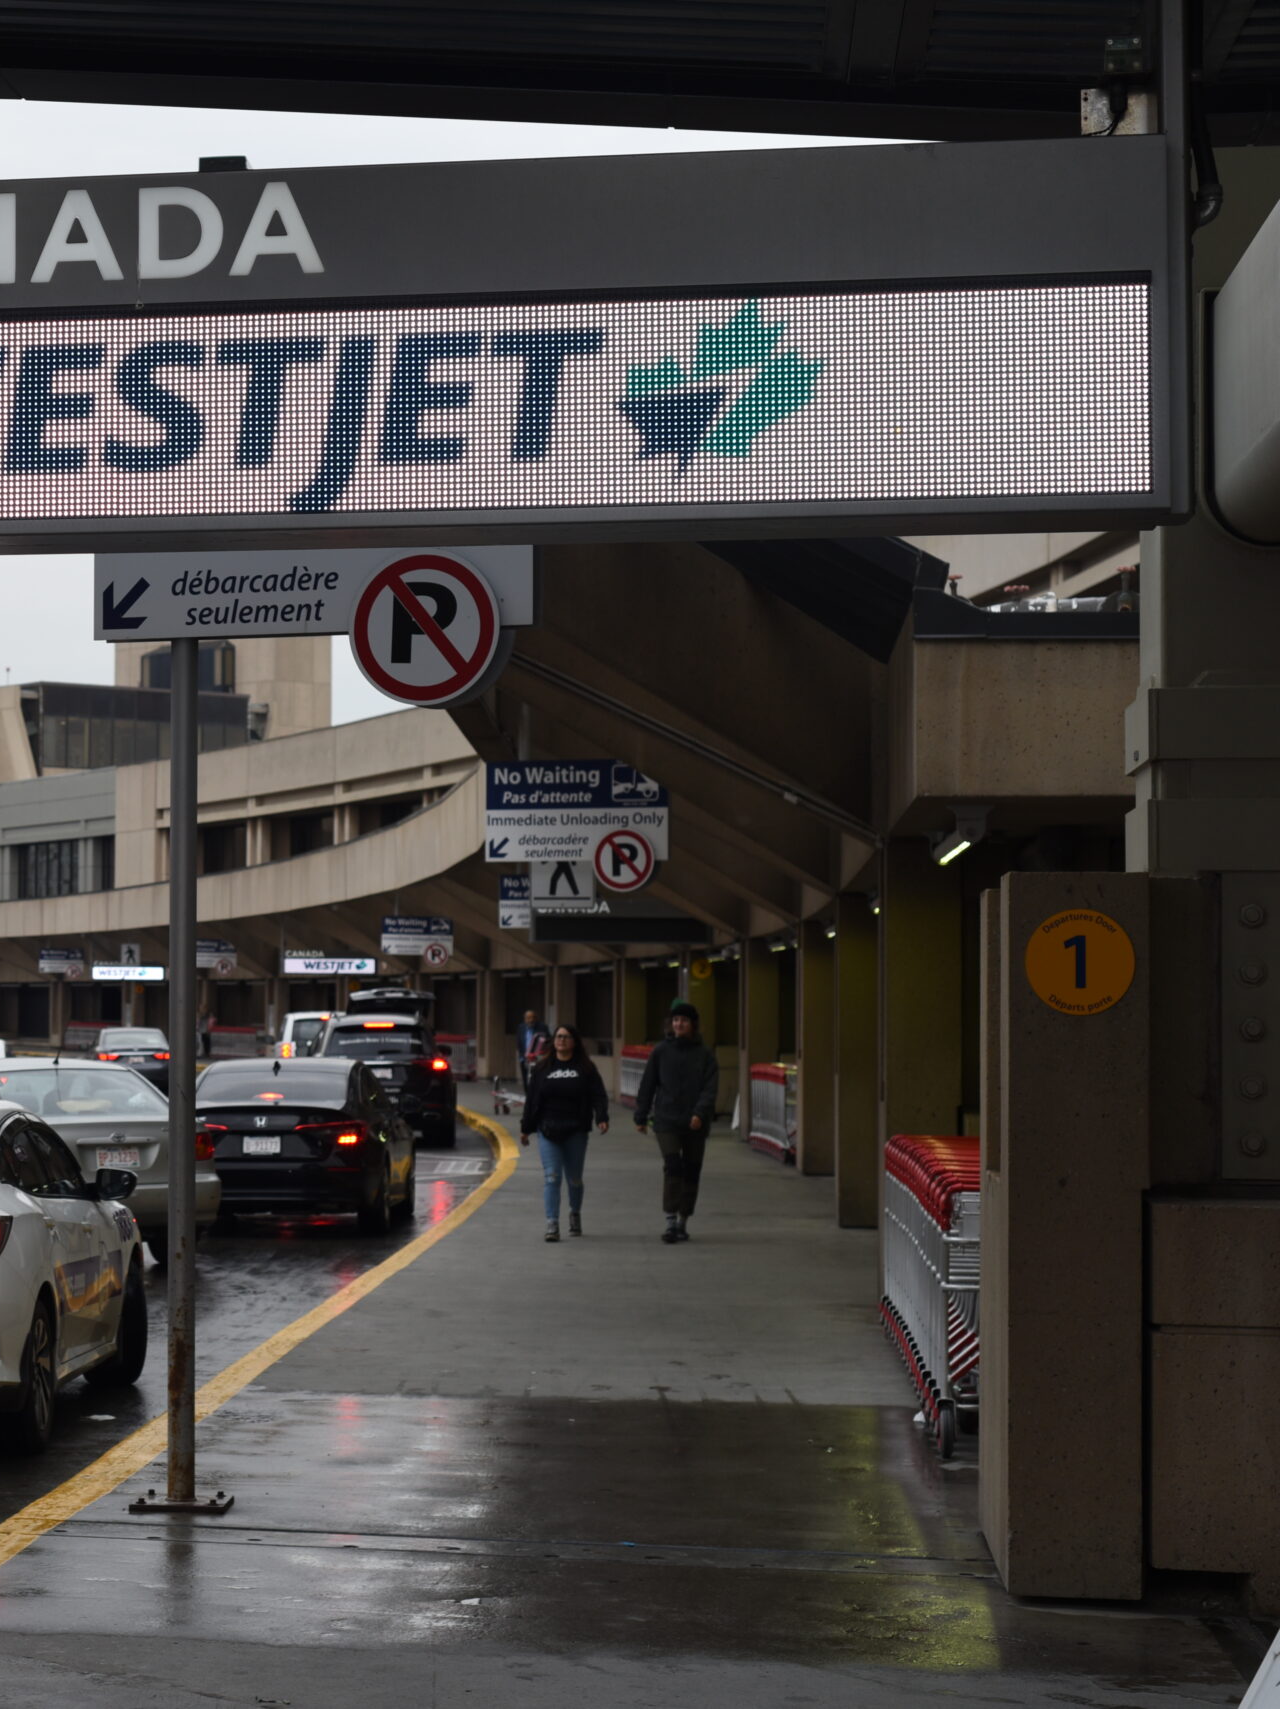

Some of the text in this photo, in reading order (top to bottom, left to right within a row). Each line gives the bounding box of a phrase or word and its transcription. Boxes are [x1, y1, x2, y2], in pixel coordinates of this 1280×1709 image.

[171, 566, 339, 596] débarcadère
[185, 599, 325, 626] seulement
[494, 766, 600, 787] No Waiting
[502, 791, 593, 804] Pas d'attente
[487, 812, 665, 828] Immediate Unloading Only
[518, 833, 589, 846] débarcadère
[524, 849, 583, 858] seulement
[1042, 913, 1117, 934] Departures Door
[304, 961, 354, 975] WESTJET
[1063, 935, 1086, 988] 1
[1087, 995, 1113, 1012] porte
